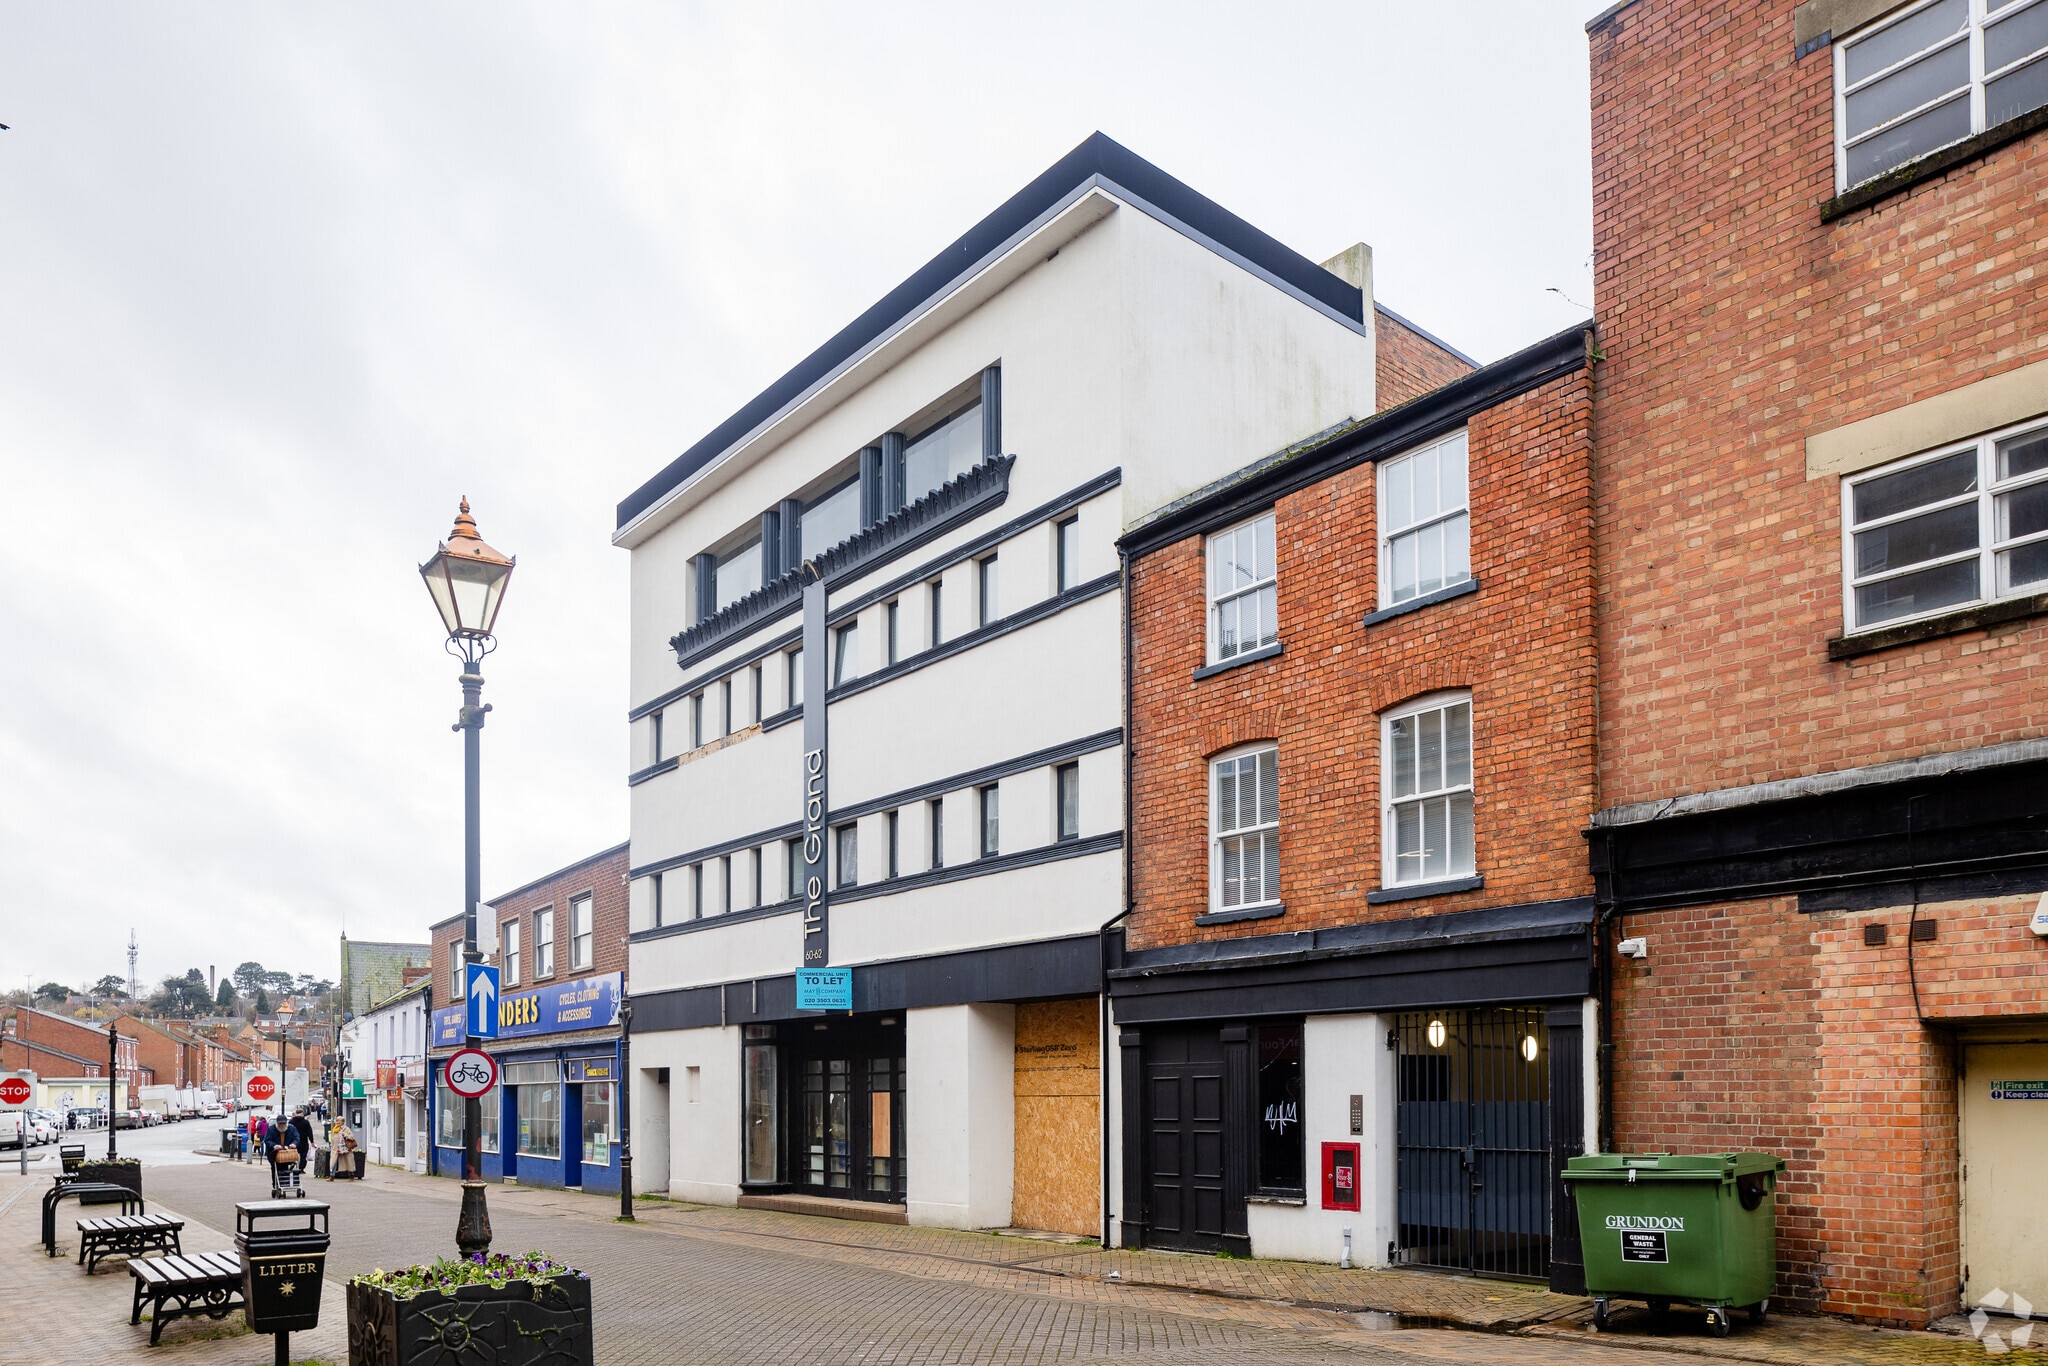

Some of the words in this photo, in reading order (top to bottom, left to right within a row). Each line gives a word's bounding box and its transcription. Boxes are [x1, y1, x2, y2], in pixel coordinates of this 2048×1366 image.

[803, 749, 822, 865] Grand
[804, 876, 822, 939] The
[805, 948, 823, 960] 60-62
[804, 976, 820, 985] TO
[823, 976, 844, 985] LET
[559, 991, 577, 1006] CYCLES,
[577, 987, 600, 1003] CLOTHING
[562, 1006, 593, 1022] ACCESSORIES
[1060, 1044, 1077, 1052] Zero
[248, 1084, 274, 1092] STOP
[2005, 1081, 2024, 1089] Fire
[2026, 1081, 2044, 1089] exit
[0, 1087, 30, 1096] STOP
[2005, 1091, 2029, 1099] Keep
[1605, 1215, 1684, 1229] GRUNDON
[259, 1262, 318, 1277] LITTER
